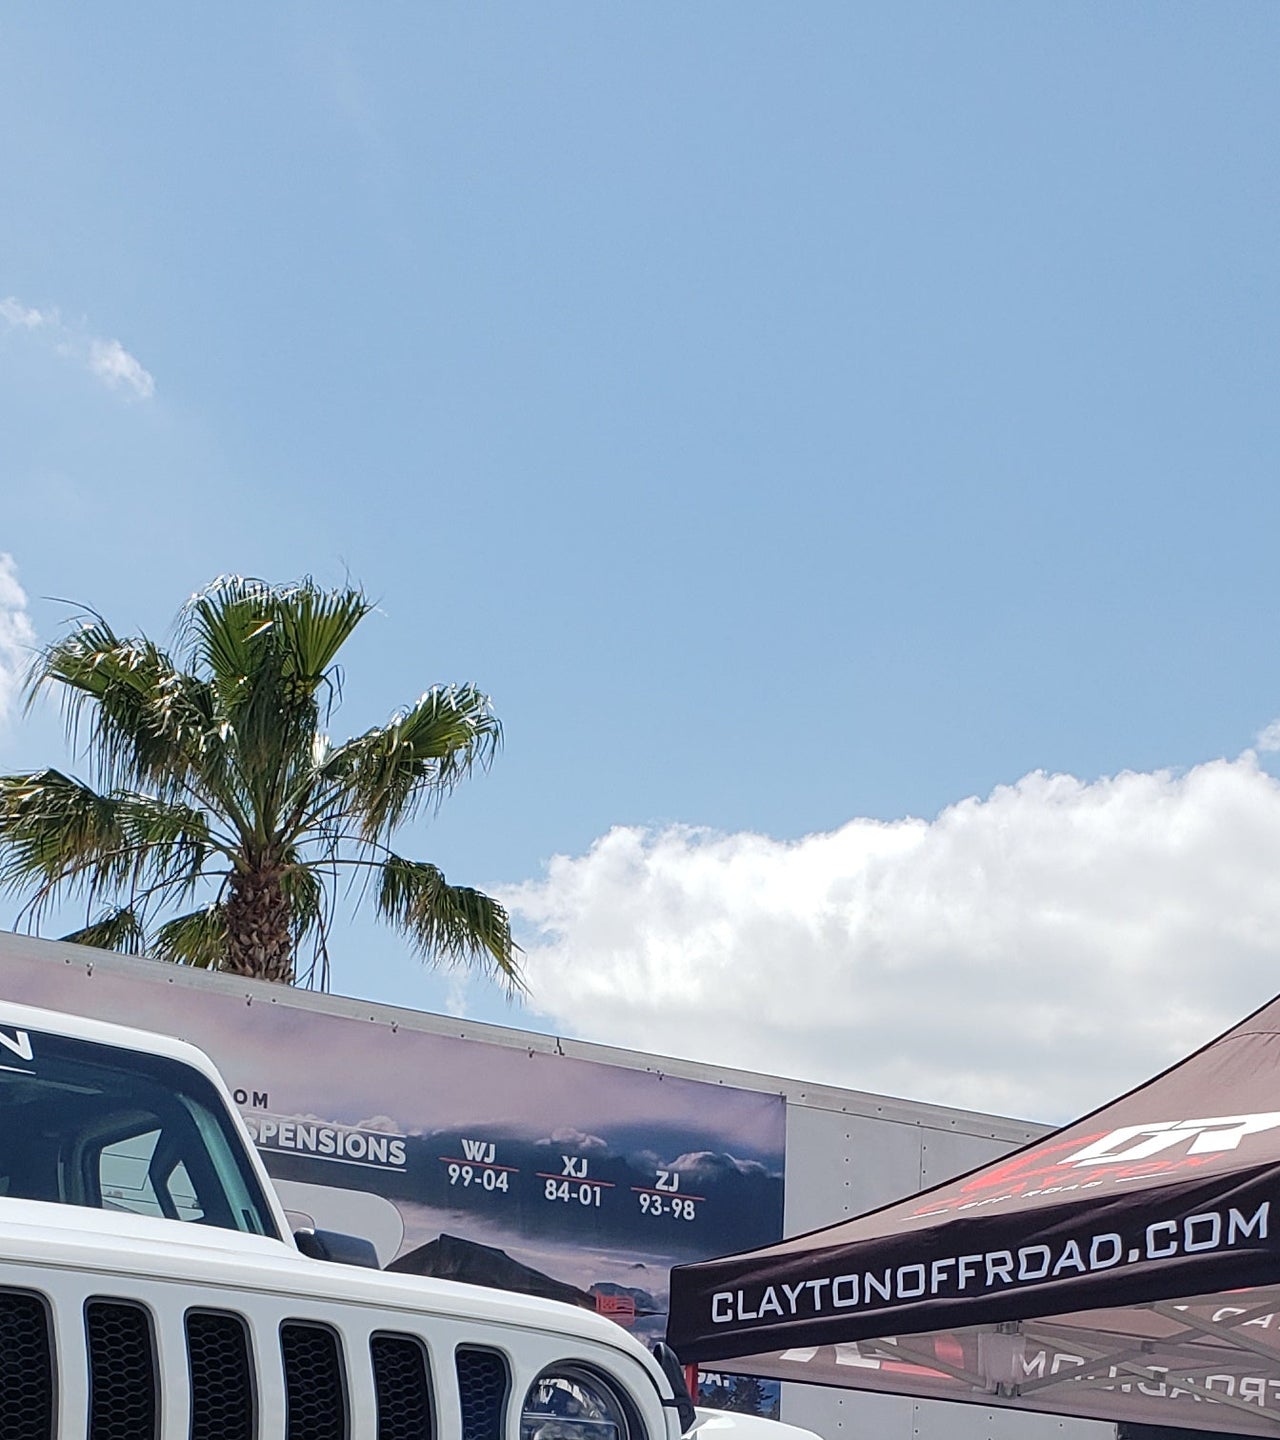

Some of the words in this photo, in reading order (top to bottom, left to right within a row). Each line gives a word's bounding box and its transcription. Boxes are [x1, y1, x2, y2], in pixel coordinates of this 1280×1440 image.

[461, 1139, 496, 1164] WJ
[447, 1164, 509, 1193] 99-04
[561, 1155, 588, 1178] XJ
[544, 1178, 602, 1207] 84-01
[655, 1170, 679, 1193] ZJ
[639, 1193, 696, 1221] 93-98
[712, 1202, 1271, 1323] CLAYTONOFFROAD.COM
